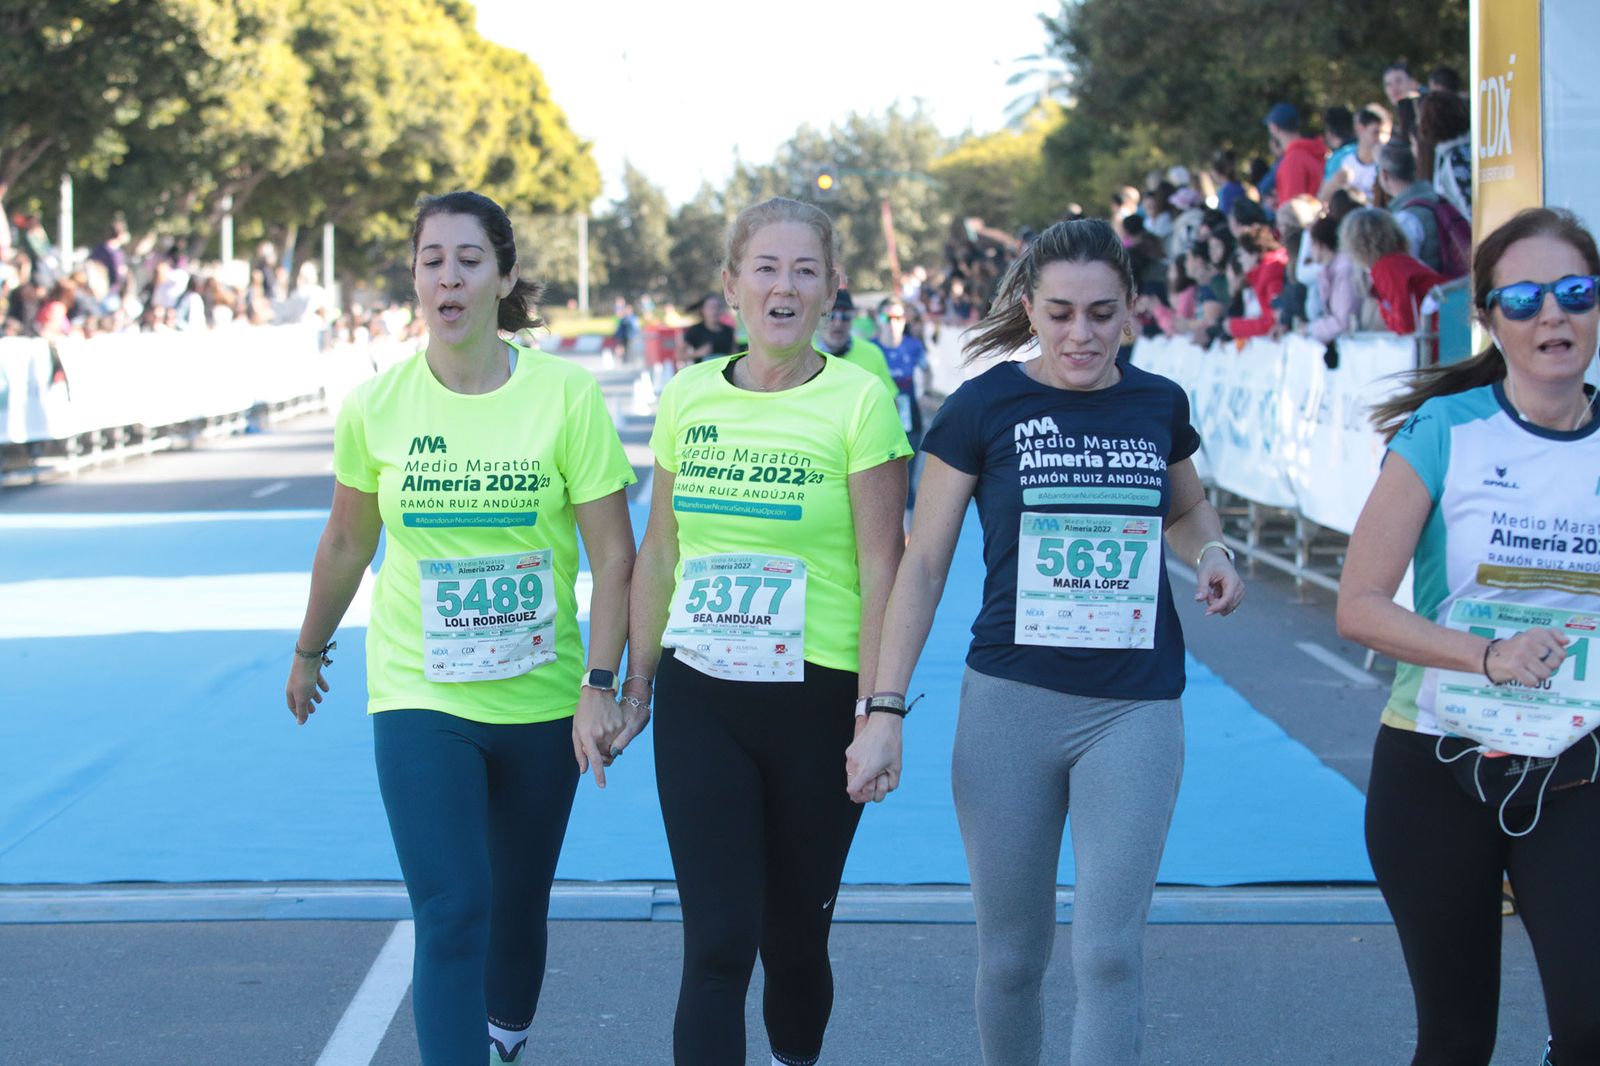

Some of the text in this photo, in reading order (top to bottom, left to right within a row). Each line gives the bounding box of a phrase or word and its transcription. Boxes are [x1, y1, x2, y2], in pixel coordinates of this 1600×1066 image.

[1479, 54, 1516, 159] CDX
[1016, 434, 1157, 454] Medio Maratón
[404, 459, 540, 473] Medio Maratón
[733, 448, 811, 467] Maratón
[1019, 450, 1104, 471] Almería
[678, 461, 745, 481] Almería
[1020, 471, 1162, 487] RAMÓN RUIZ ANDÚJAR
[402, 475, 481, 492] Almería
[709, 486, 738, 496] RUIZ
[743, 488, 805, 501] ANDÚJAR
[400, 498, 540, 509] RAMÓN RUIZ ANDÚJAR
[1491, 511, 1547, 530] Medio
[1490, 528, 1600, 555] Almería 20
[1036, 537, 1148, 579] 5637
[1488, 553, 1533, 567] RAMÓN
[1537, 559, 1565, 570] RUIZ
[486, 564, 504, 572] 2022
[1053, 577, 1130, 590] MARÍA LÓPEZ
[436, 573, 543, 618] 5489
[685, 576, 792, 615] 5377
[445, 611, 536, 627] LOLI RODRÍGUEZ
[693, 612, 772, 625] BEA ANDÚJAR
